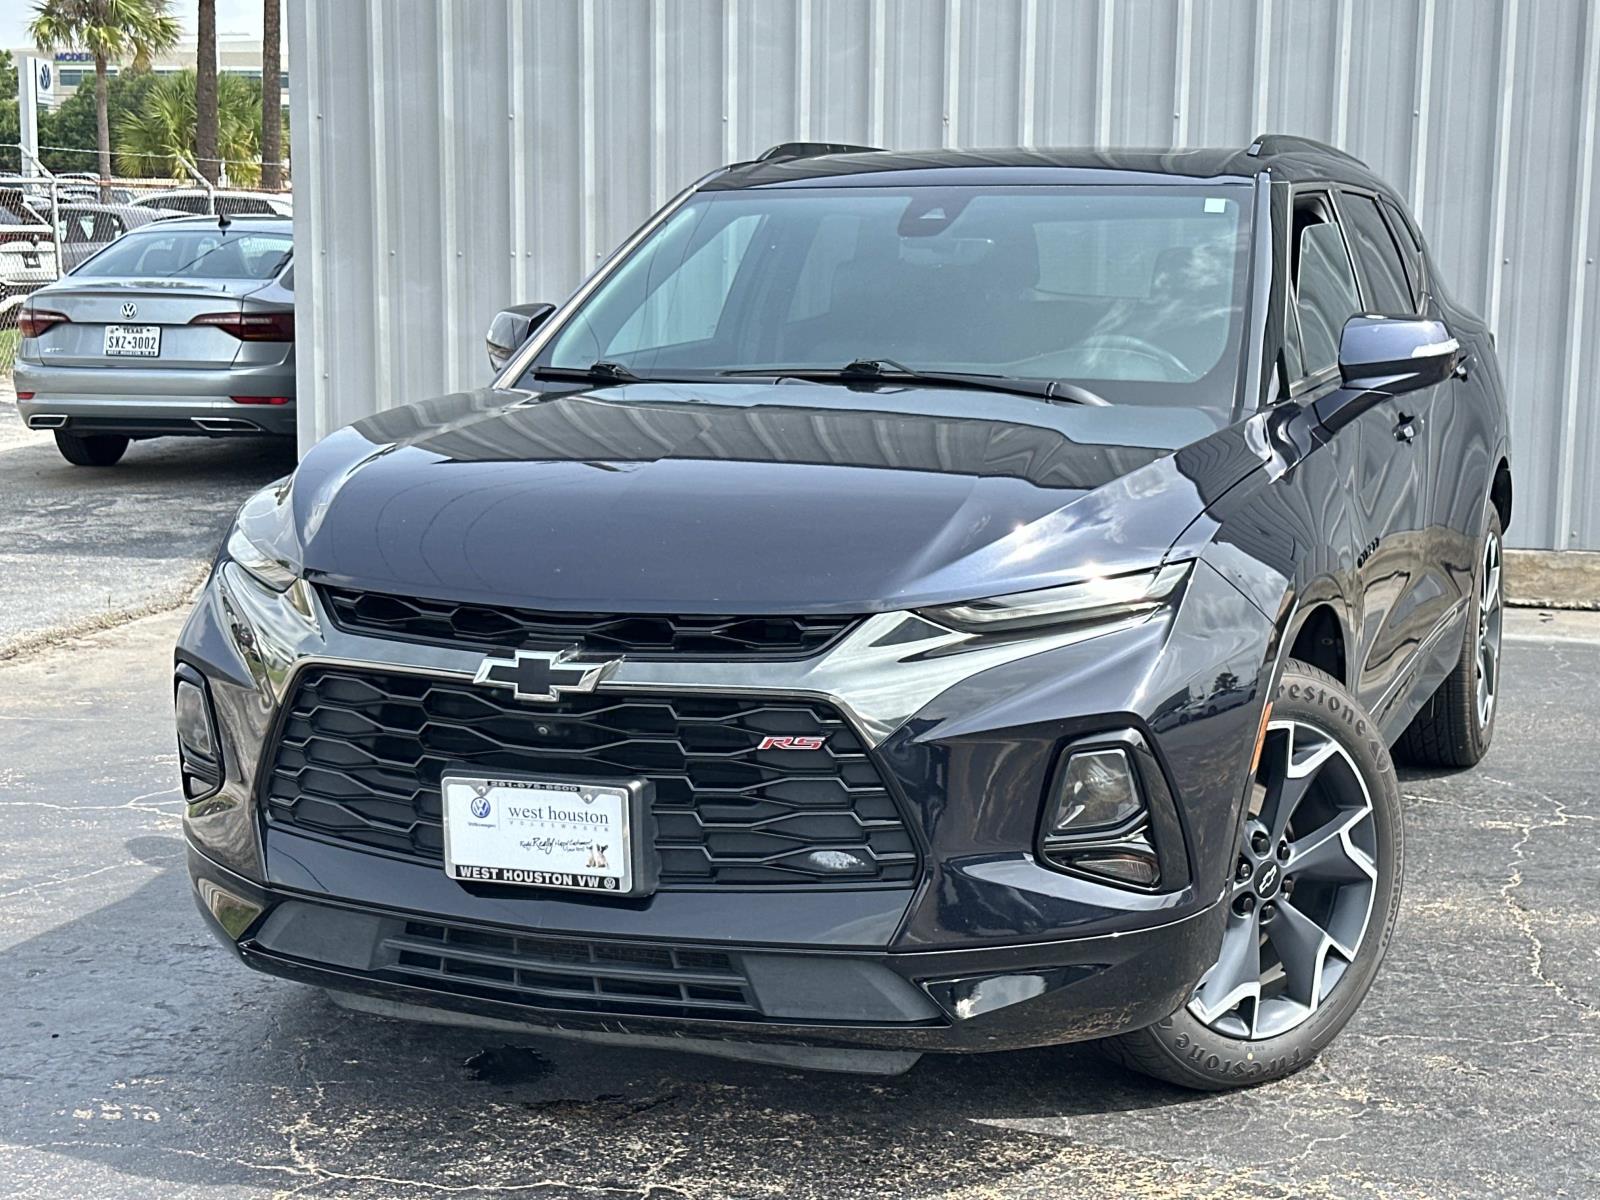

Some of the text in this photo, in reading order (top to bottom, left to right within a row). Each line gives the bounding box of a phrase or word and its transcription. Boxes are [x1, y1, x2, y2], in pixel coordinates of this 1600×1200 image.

[1276, 684, 1368, 737] restone
[756, 735, 826, 750] RS
[508, 805, 609, 824] west houston
[459, 866, 600, 888] WEST HOUSTON VW
[1175, 1032, 1303, 1078] Firestone
